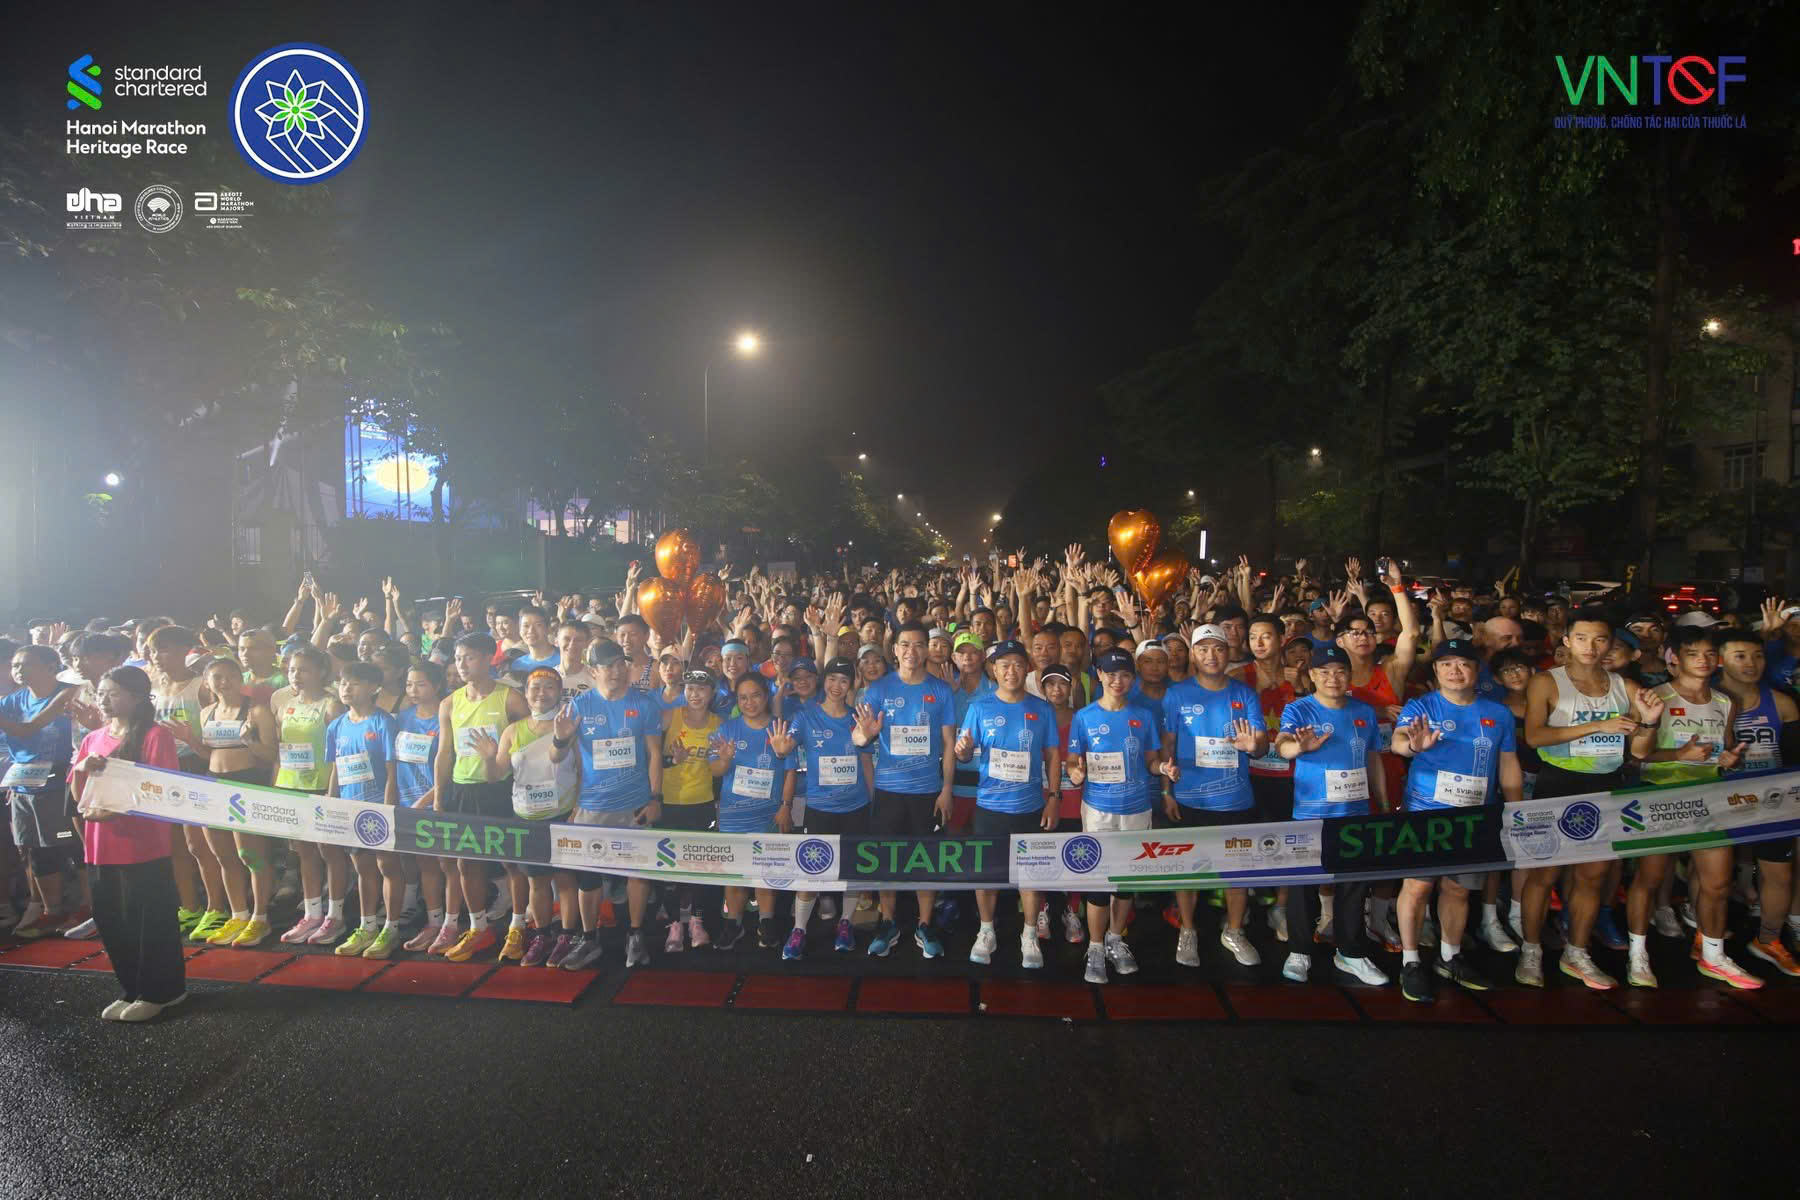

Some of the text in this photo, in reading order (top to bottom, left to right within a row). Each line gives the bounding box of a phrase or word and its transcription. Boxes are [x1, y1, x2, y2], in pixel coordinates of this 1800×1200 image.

[1672, 718, 1725, 728] ANTA
[1736, 728, 1776, 743] SA
[608, 748, 631, 756] 10021
[528, 791, 554, 800] 19930
[252, 802, 296, 817] standard
[1649, 797, 1704, 812] standard
[252, 812, 298, 825] chartered
[1651, 808, 1710, 822] chartered
[416, 819, 529, 857] START
[1338, 813, 1485, 858] START
[683, 844, 731, 853] standard
[1134, 842, 1195, 860] XTEP
[683, 853, 734, 862] chartered
[856, 841, 992, 874] START
